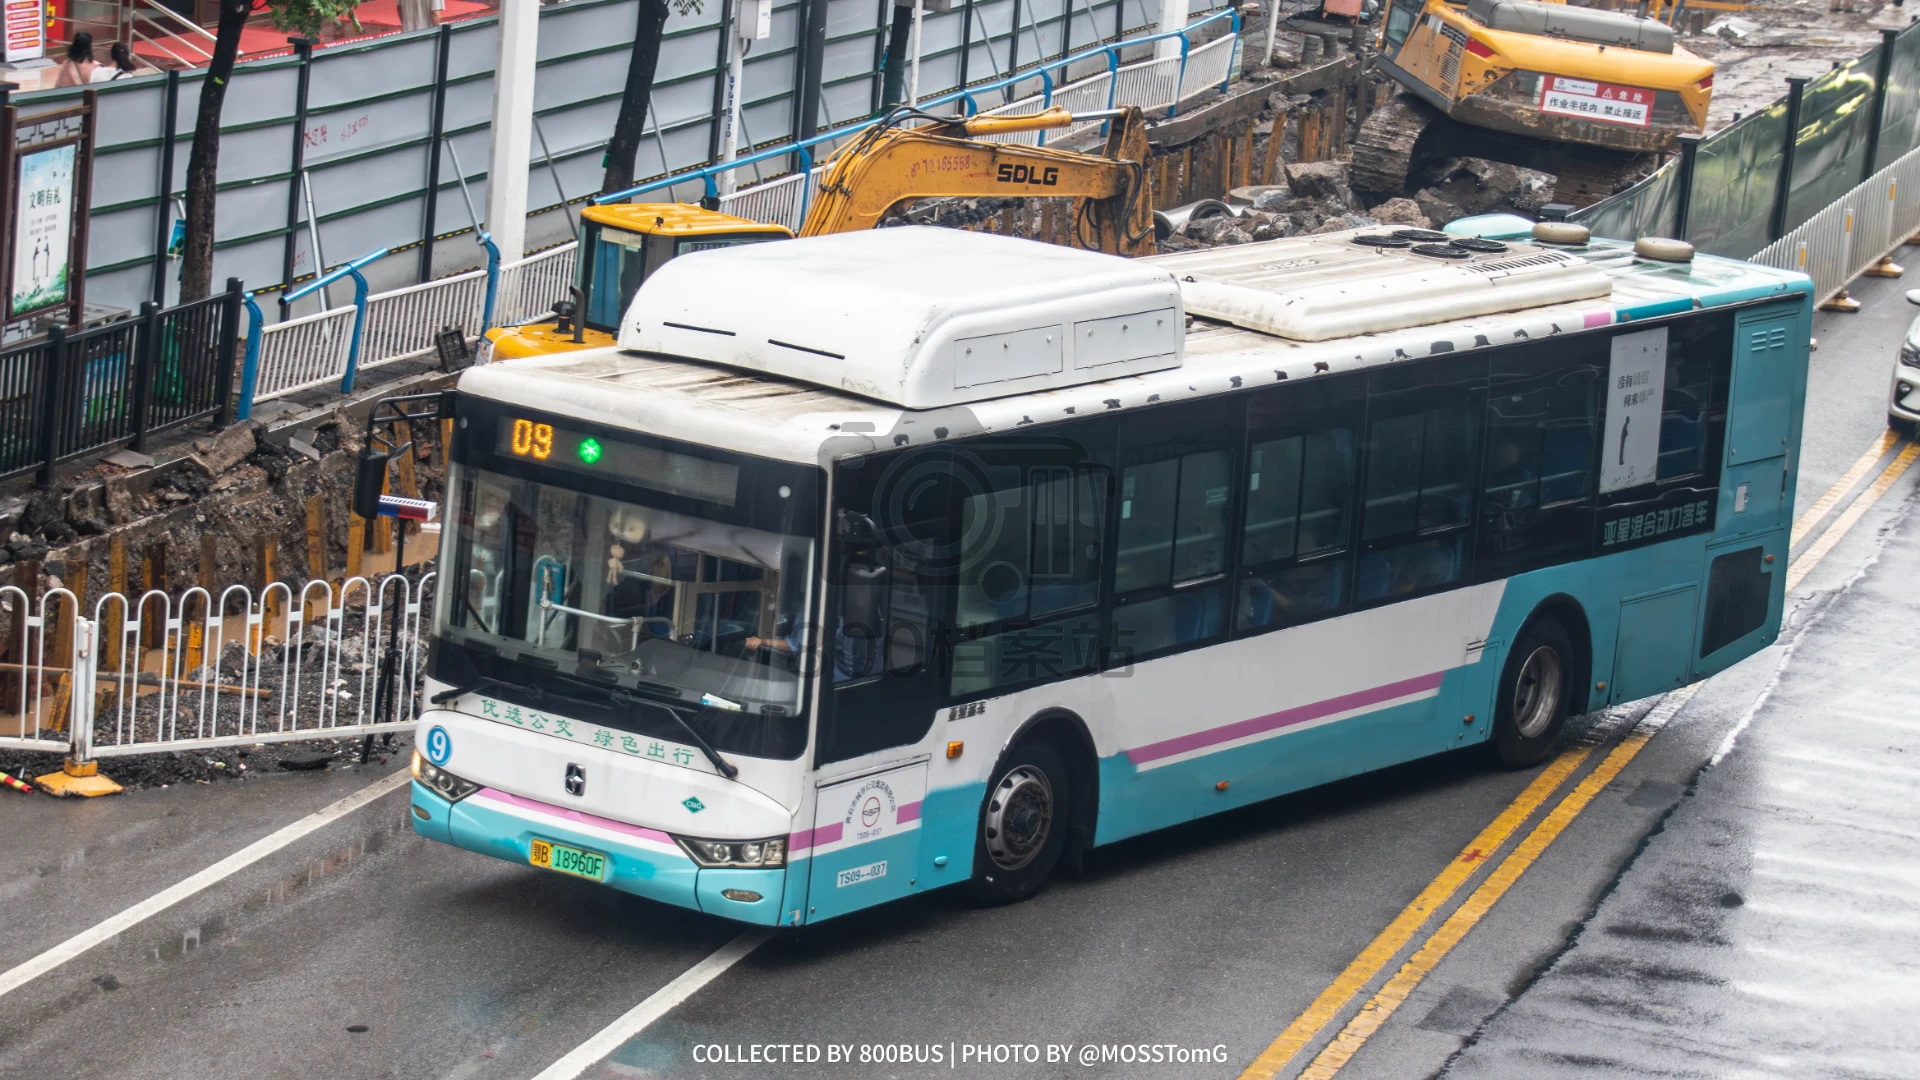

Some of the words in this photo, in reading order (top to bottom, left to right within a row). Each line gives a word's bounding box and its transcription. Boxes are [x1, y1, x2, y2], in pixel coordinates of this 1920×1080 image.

[1549, 96, 1598, 113] 作业半径内
[1603, 105, 1642, 120] 禁止接近
[1618, 90, 1643, 103] 危险
[997, 163, 1059, 186] SDLG
[28, 185, 62, 211] 文明有礼
[512, 418, 553, 459] 09
[1603, 500, 1709, 546] 亚星混合动力客车
[480, 698, 575, 738] 优选公交
[593, 728, 695, 766] 绿色出行
[432, 728, 448, 764] 9
[685, 800, 702, 810] CNG
[555, 848, 603, 876] 18960F
[839, 862, 886, 886] TS09--037
